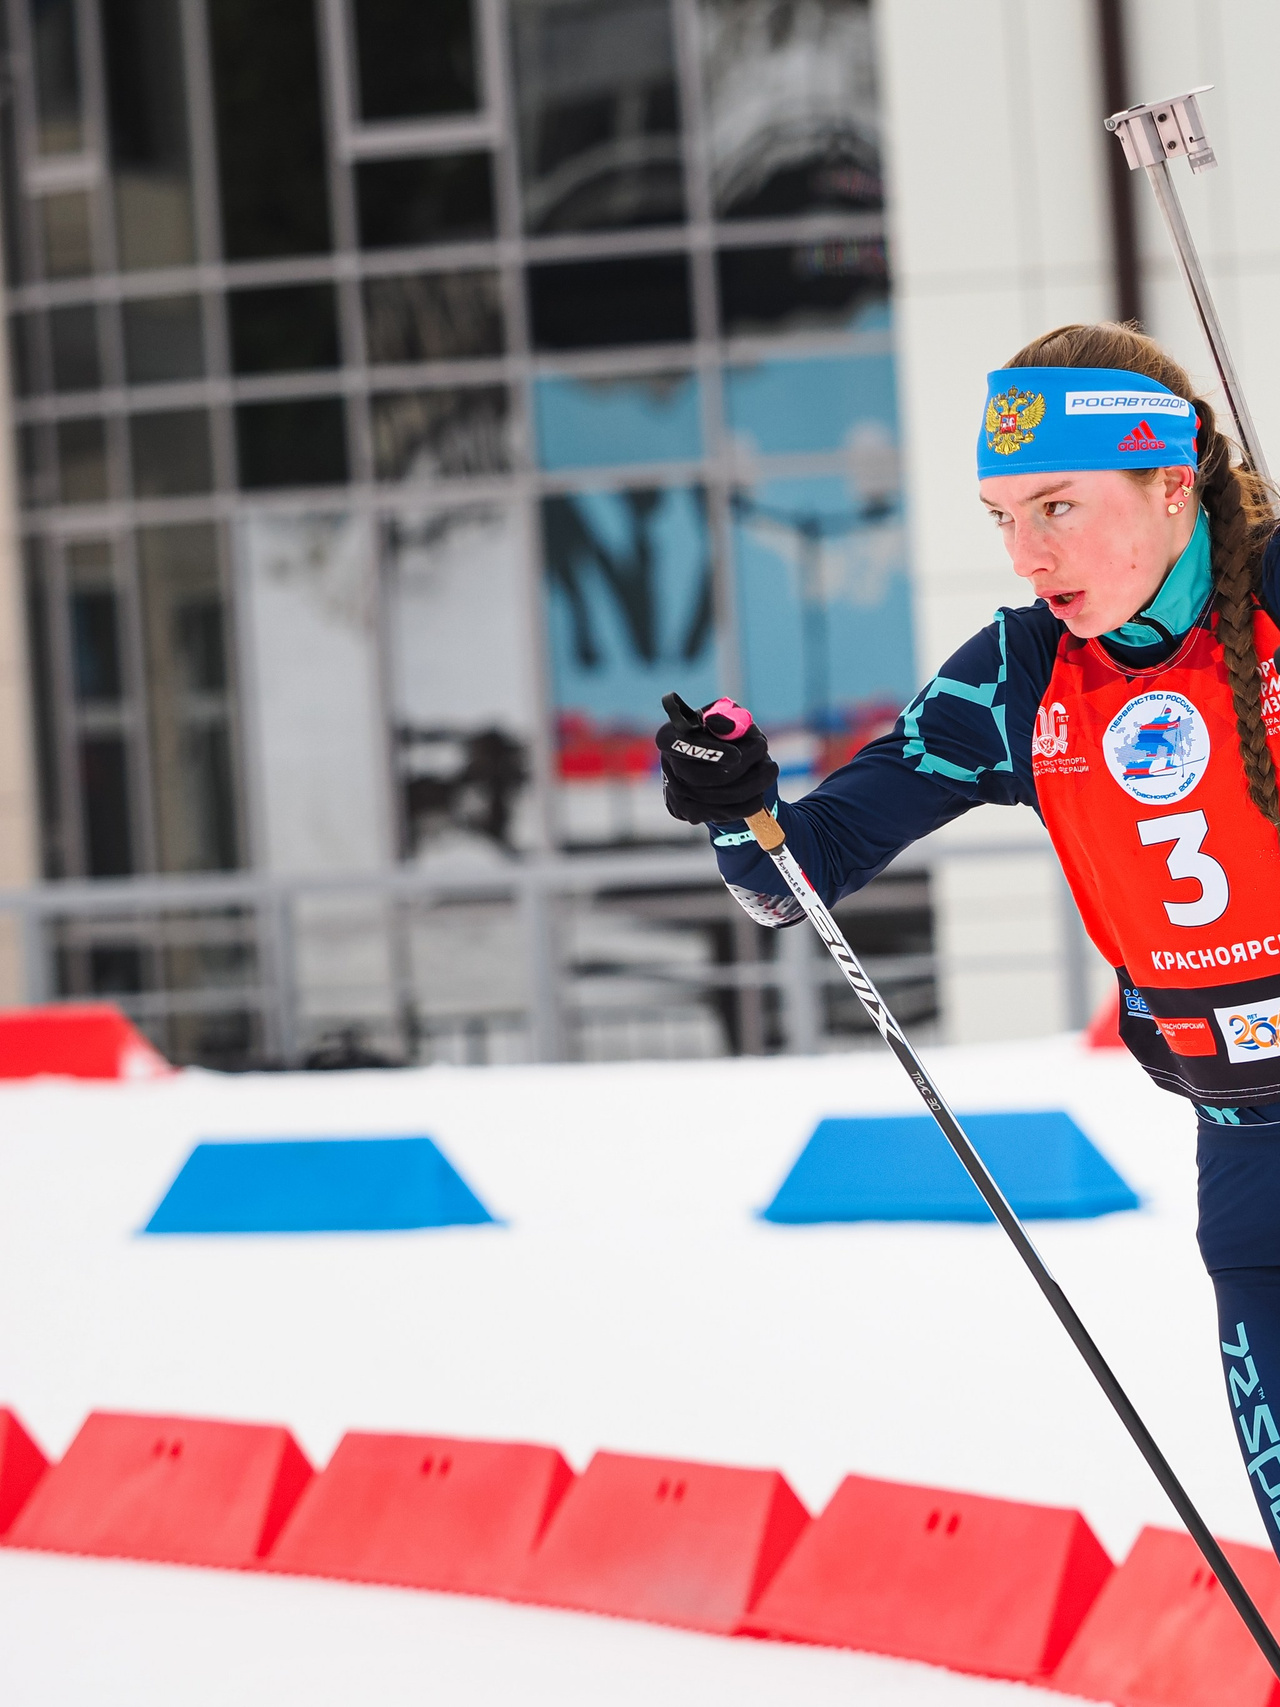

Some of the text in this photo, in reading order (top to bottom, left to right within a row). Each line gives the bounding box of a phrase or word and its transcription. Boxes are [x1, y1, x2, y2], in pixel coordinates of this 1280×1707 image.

[1072, 397, 1186, 408] РОСАВТОДОР
[1117, 439, 1166, 452] adidas
[1109, 693, 1194, 732] ПЕРВЕНСТВО РОССИИ
[1132, 787, 1177, 800] Красноярск
[1179, 772, 1196, 792] 2023
[1136, 809, 1230, 927] 3
[808, 904, 905, 1045] SWIX
[1228, 1014, 1277, 1048] 20
